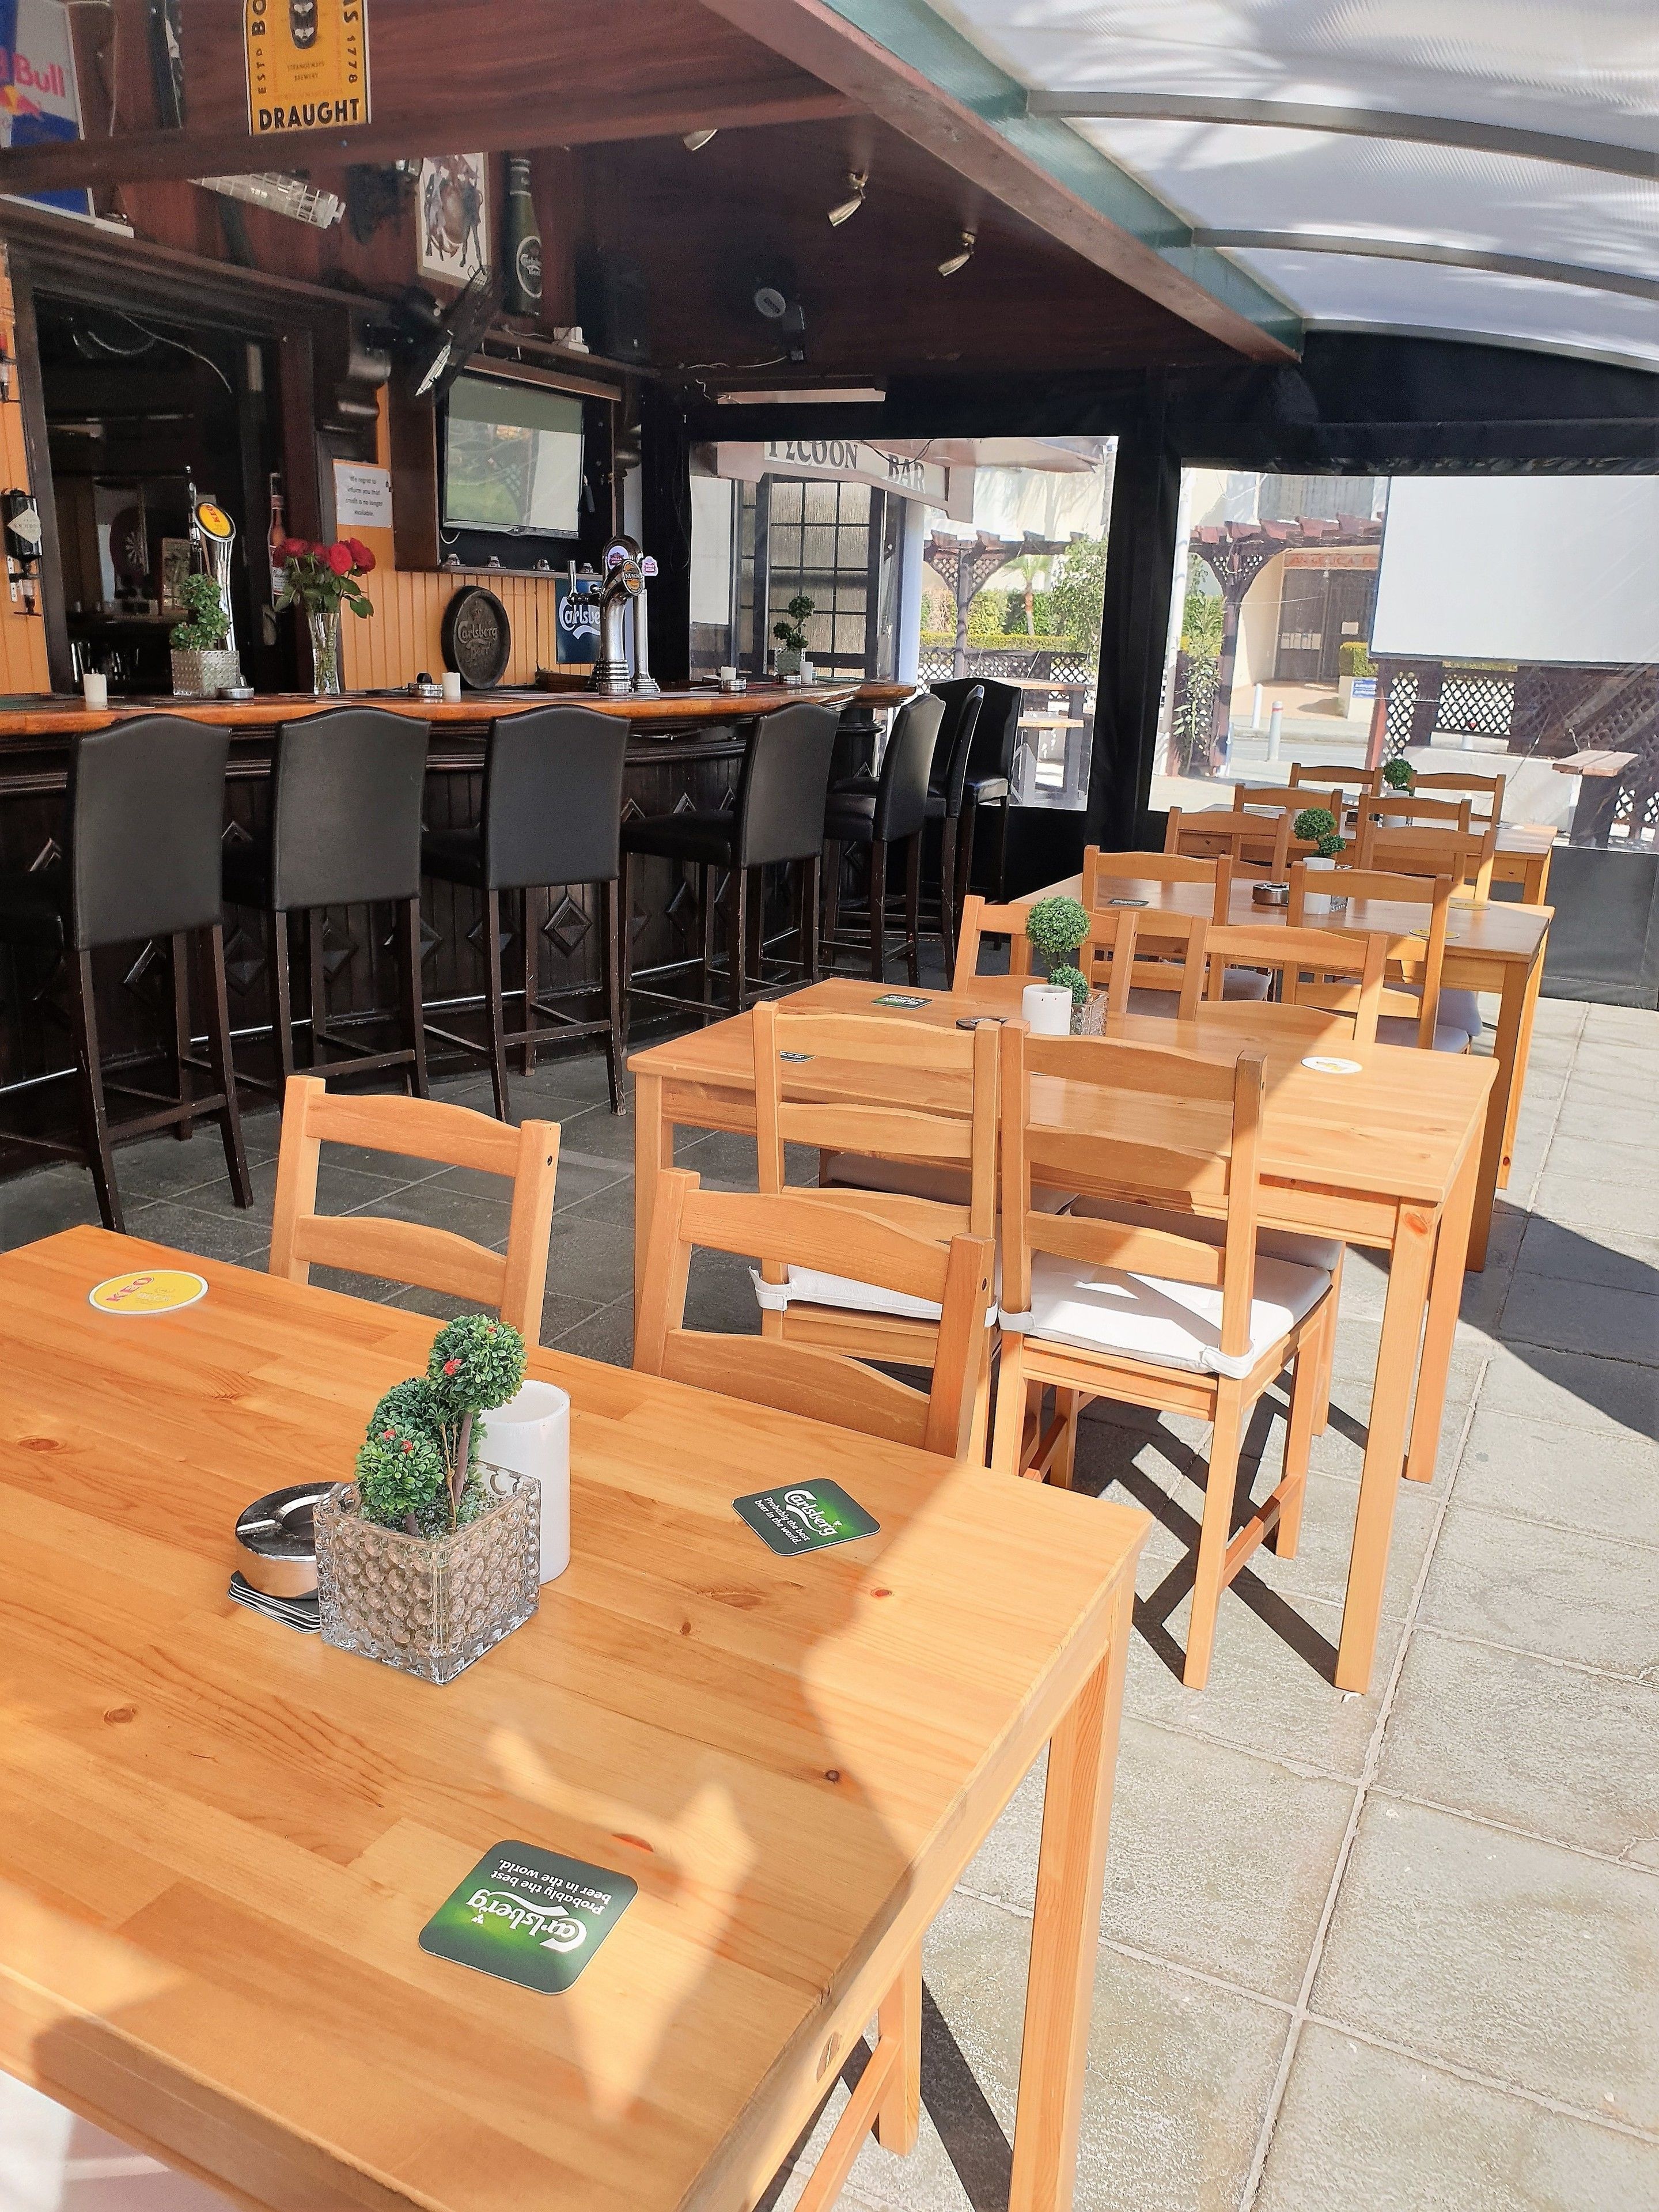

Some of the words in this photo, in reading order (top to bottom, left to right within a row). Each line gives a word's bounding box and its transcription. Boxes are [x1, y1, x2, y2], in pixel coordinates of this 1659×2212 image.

[347, 35, 358, 84] 1778
[14, 52, 65, 99] Bull
[260, 99, 359, 131] DRAUGHT
[888, 453, 925, 494] BAR
[559, 596, 600, 631] Carlsbe
[457, 620, 498, 644] Carlsberg
[106, 1277, 154, 1302] KEO
[753, 1499, 770, 1513] beer
[766, 1510, 775, 1519] in
[771, 1517, 782, 1528] the
[781, 1527, 802, 1545] world.
[764, 1497, 790, 1521] Probably
[786, 1519, 798, 1529] the
[796, 1528, 811, 1541] best
[784, 1490, 838, 1536] Carlsberg
[490, 1870, 520, 1887] best
[499, 1859, 540, 1880] world.
[541, 1873, 564, 1888] the
[520, 1880, 543, 1893] the
[543, 1885, 605, 1915] Probably
[565, 1881, 581, 1892] in
[579, 1887, 612, 1905] beer
[465, 1889, 588, 1953] Carlsberg
